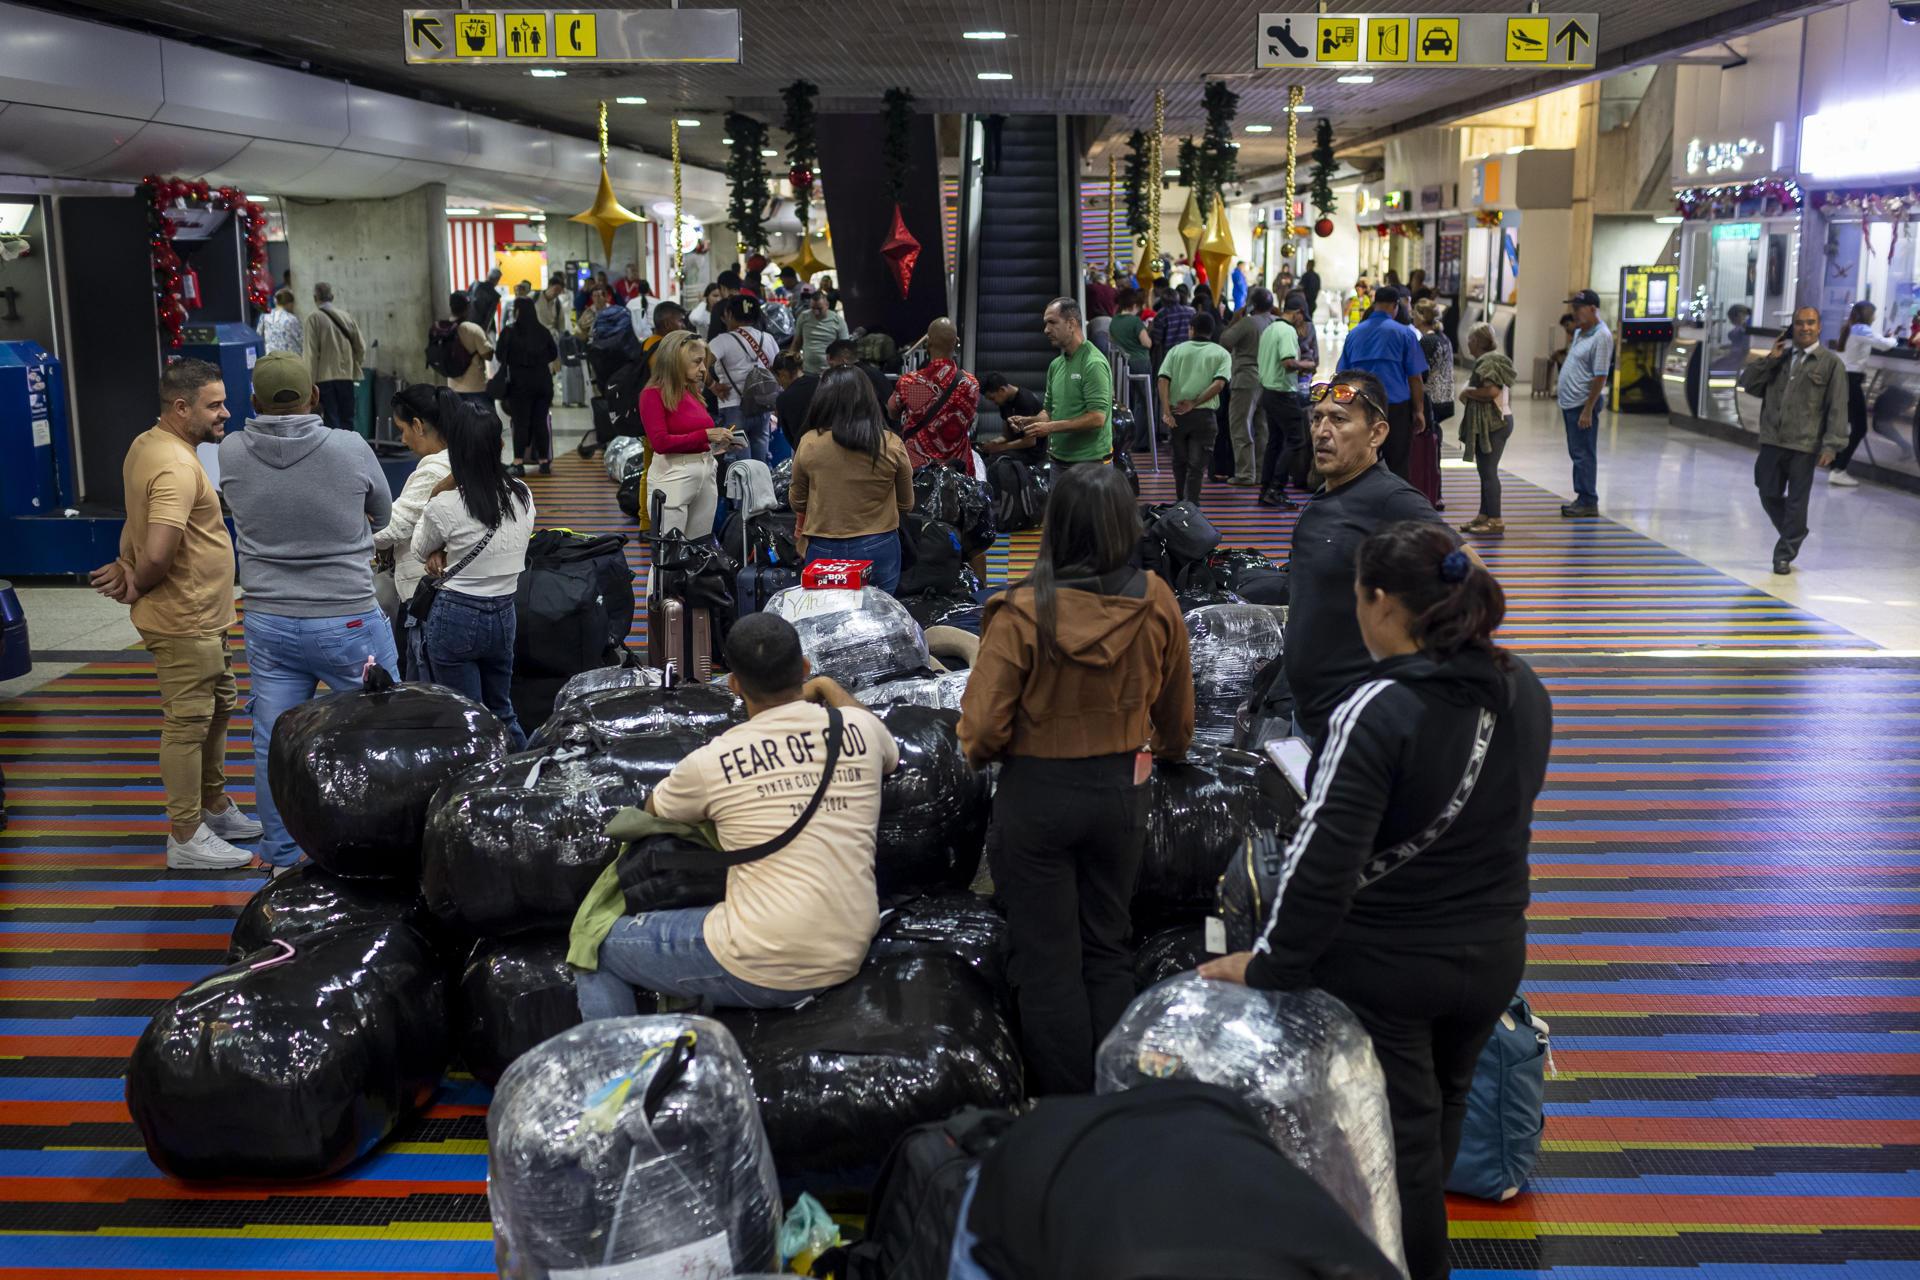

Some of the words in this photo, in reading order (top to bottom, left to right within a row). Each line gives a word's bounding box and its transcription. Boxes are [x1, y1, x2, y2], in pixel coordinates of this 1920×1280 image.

[719, 738, 785, 784] FEAR
[786, 730, 816, 764] OF
[757, 777, 794, 798] SIXTH
[795, 767, 862, 789] COLLTION
